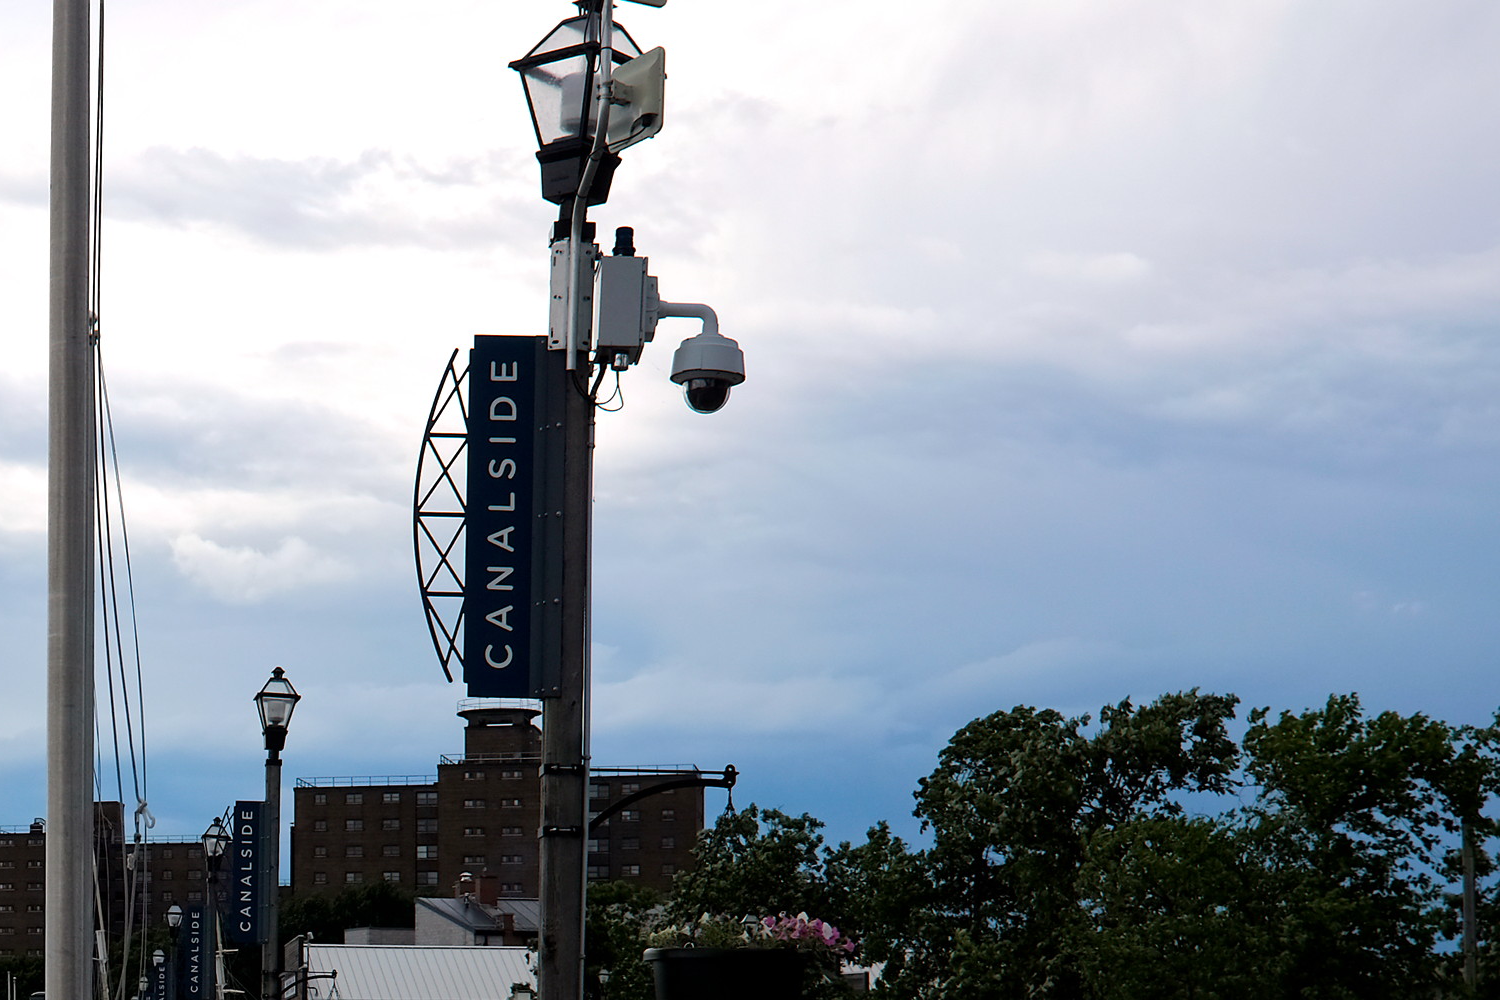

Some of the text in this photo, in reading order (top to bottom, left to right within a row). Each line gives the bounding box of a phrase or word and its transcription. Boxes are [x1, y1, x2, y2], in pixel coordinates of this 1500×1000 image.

[485, 360, 518, 669] CANALSIDE
[239, 809, 254, 933] CANALSIDE
[188, 910, 201, 994] CANALSIDE
